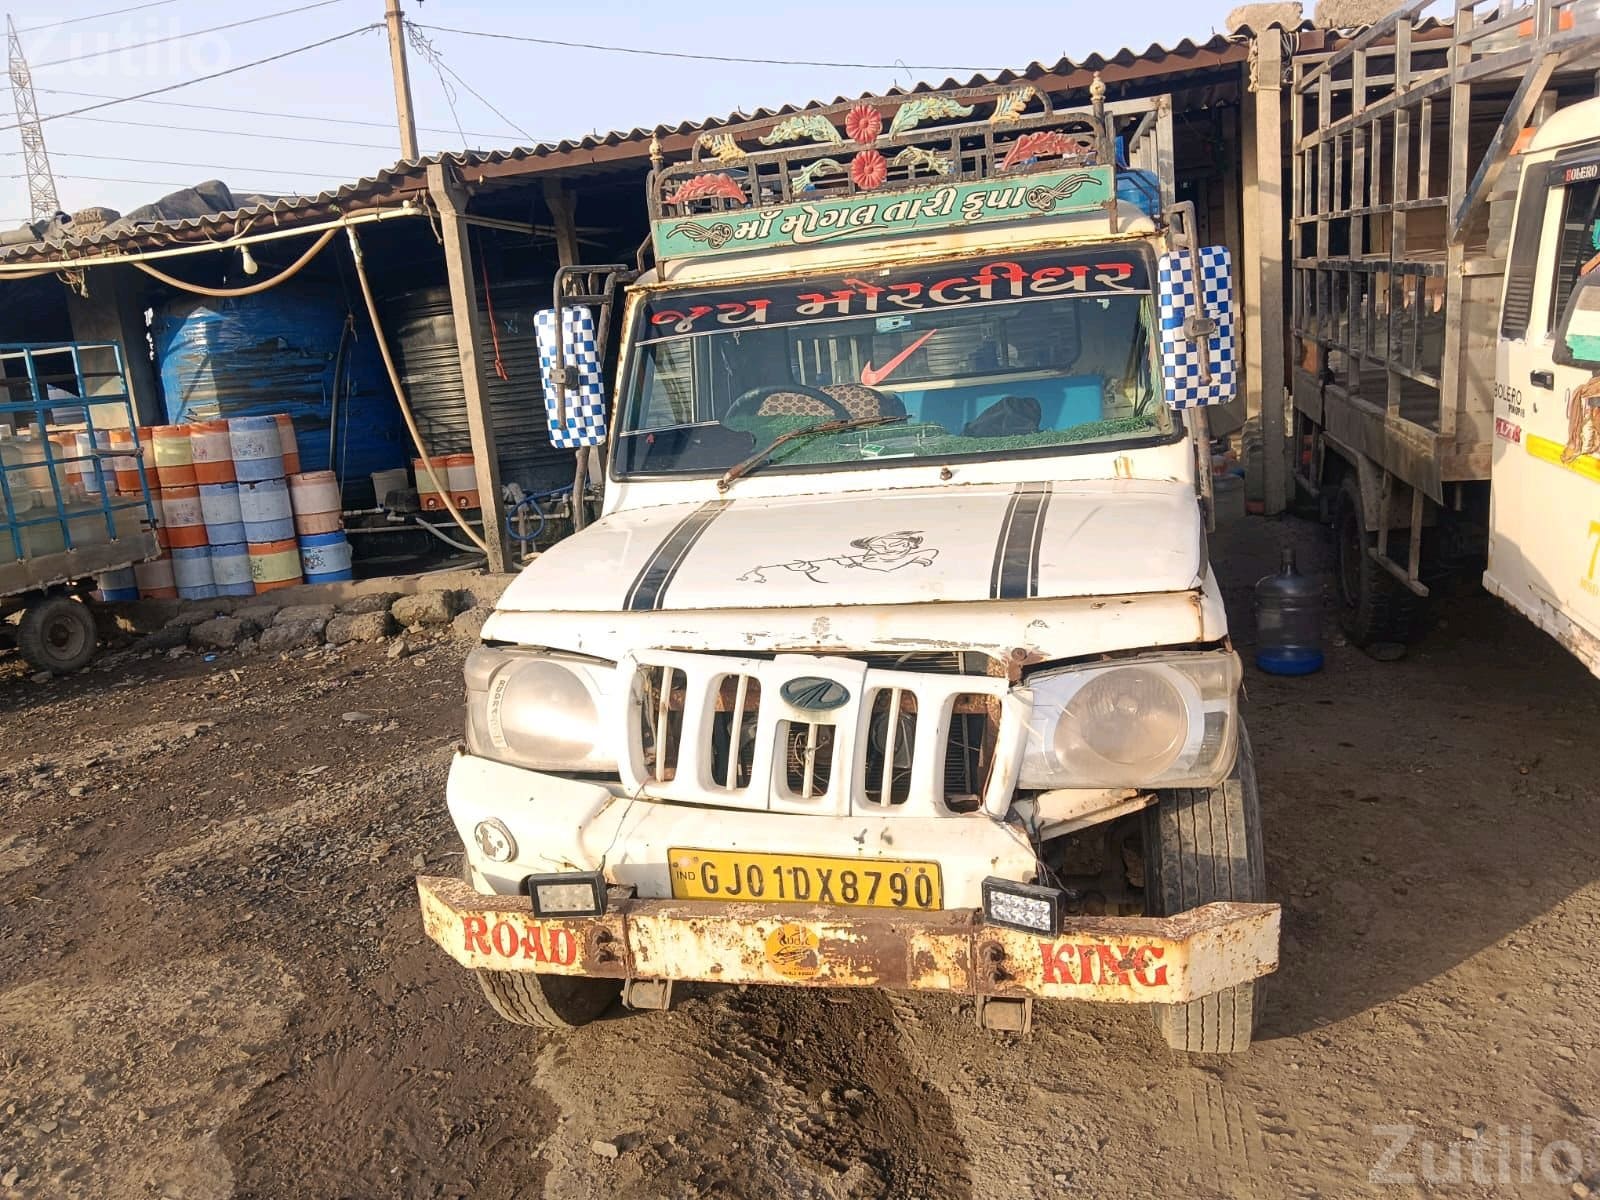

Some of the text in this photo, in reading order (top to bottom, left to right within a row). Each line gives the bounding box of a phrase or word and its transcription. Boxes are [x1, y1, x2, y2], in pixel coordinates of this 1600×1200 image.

[1565, 164, 1598, 182] BOLERO
[780, 206, 888, 244] મોગલ
[882, 187, 958, 222] તારી
[650, 262, 1135, 333] જય મોરલીધર
[676, 861, 933, 908] IND GJ01DX8790
[462, 915, 1168, 987] ROAD KING
